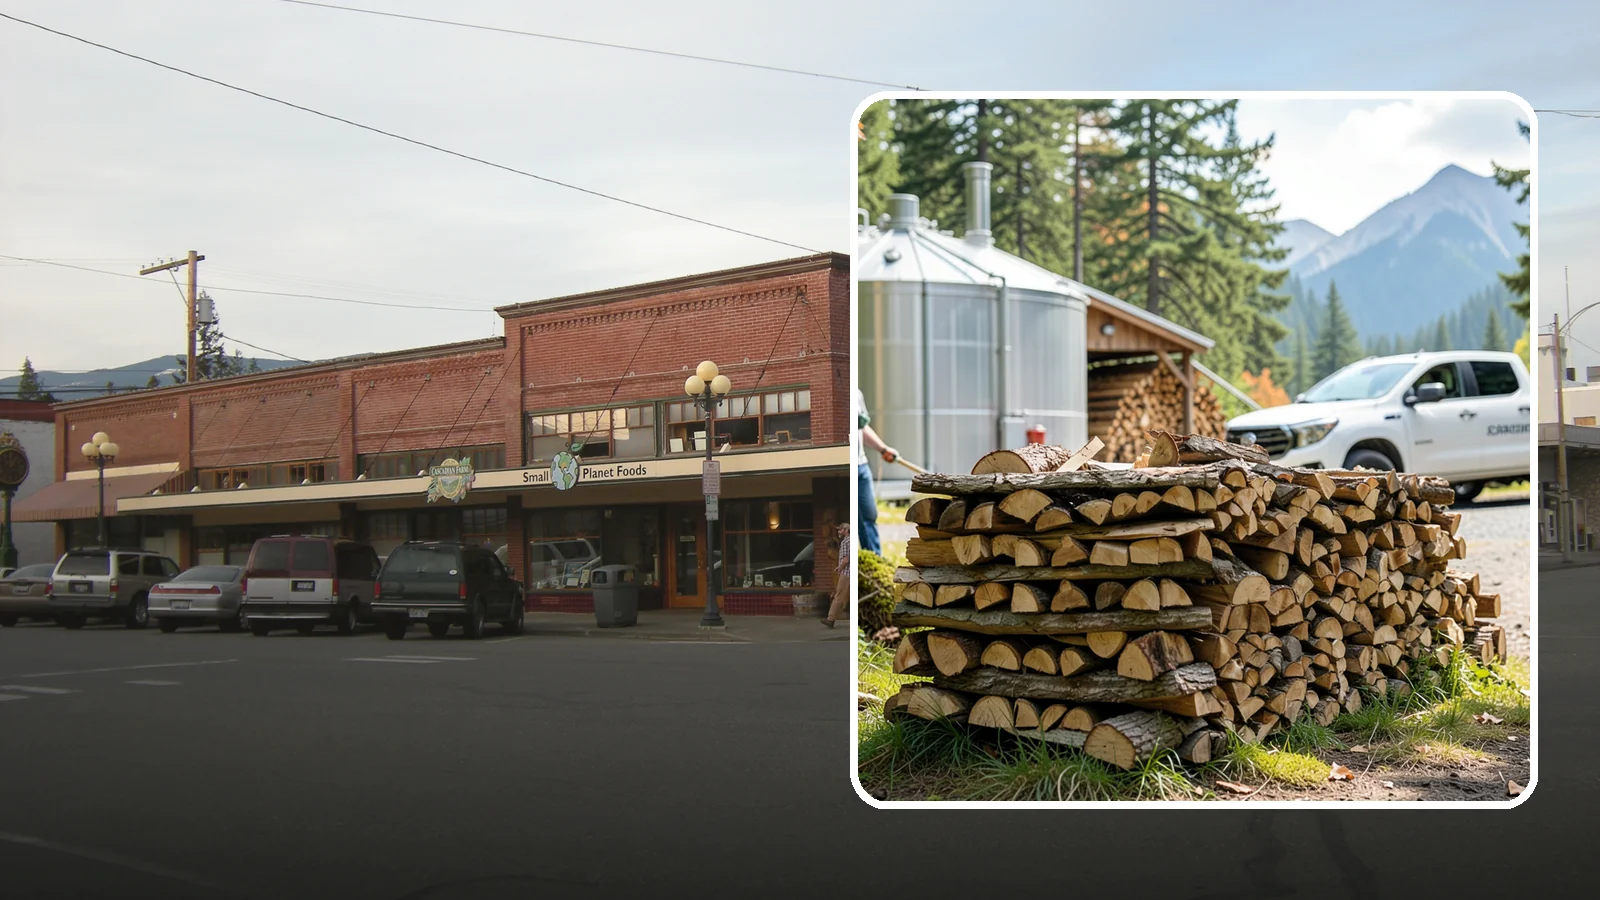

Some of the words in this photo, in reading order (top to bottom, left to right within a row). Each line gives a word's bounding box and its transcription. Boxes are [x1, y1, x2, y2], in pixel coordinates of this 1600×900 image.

[523, 471, 549, 483] Small
[583, 467, 614, 479] Planet
[617, 464, 647, 477] Foods
